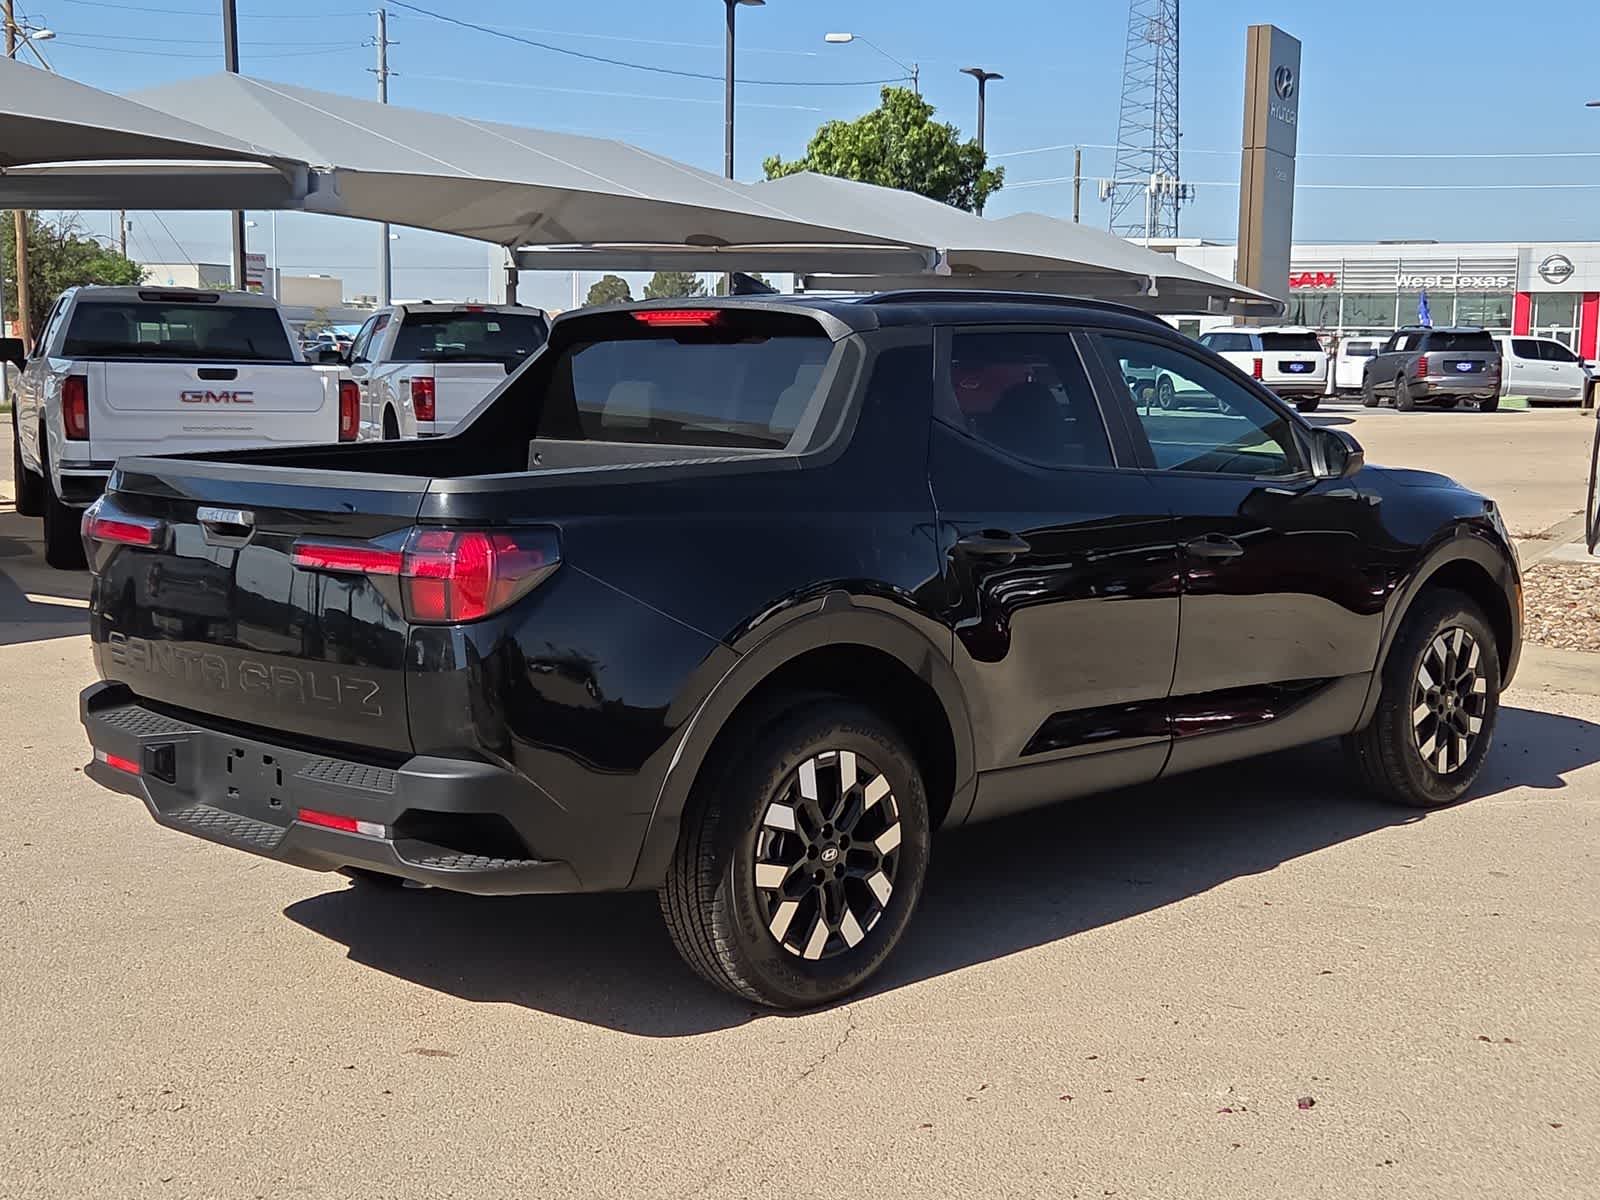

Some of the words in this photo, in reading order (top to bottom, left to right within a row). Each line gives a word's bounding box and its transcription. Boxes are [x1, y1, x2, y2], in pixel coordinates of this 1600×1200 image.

[1395, 274, 1441, 288] West
[1447, 274, 1509, 289] Texas
[181, 390, 254, 404] GMC
[107, 629, 230, 689] SANTA
[237, 658, 383, 718] CRUZ
